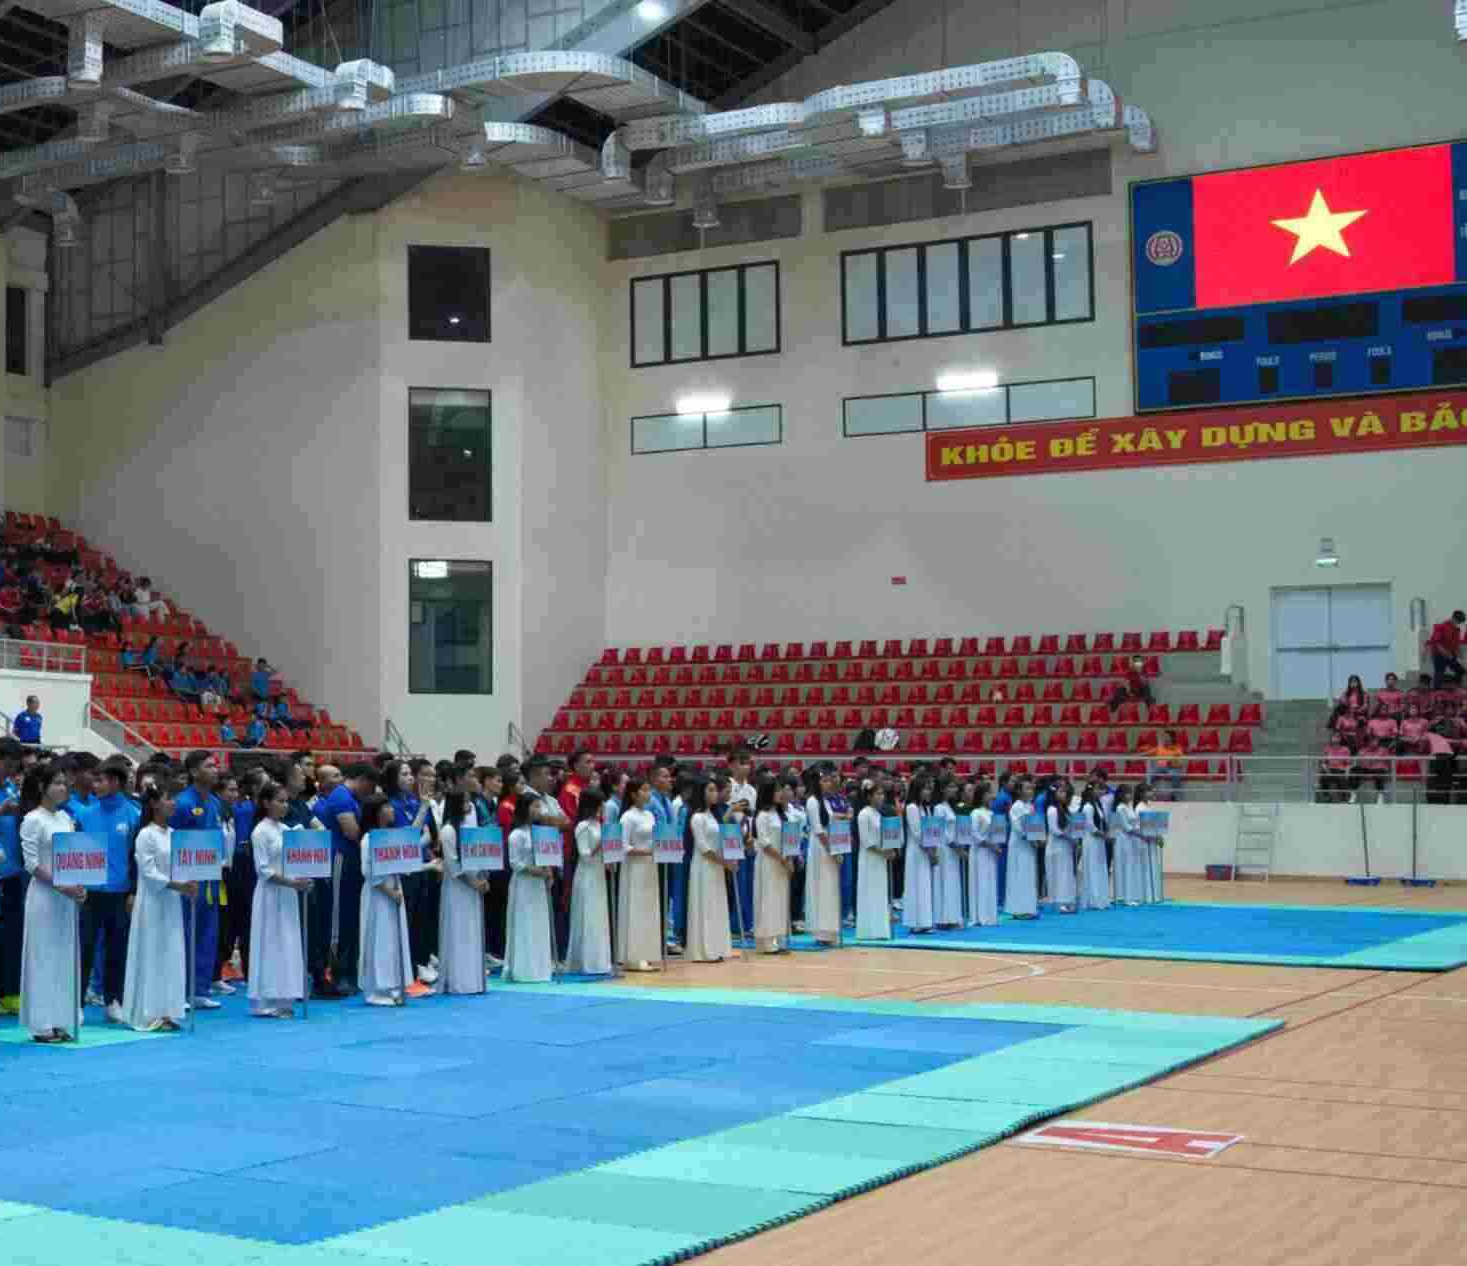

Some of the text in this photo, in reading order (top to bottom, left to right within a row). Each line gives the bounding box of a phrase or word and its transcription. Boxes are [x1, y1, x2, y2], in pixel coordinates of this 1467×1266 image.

[940, 435, 1037, 466] KHỎE
[1048, 428, 1101, 458] ĐỂ
[1109, 427, 1188, 453] XÂY
[1200, 420, 1316, 449] DỰNG
[1329, 411, 1385, 438] VÀ
